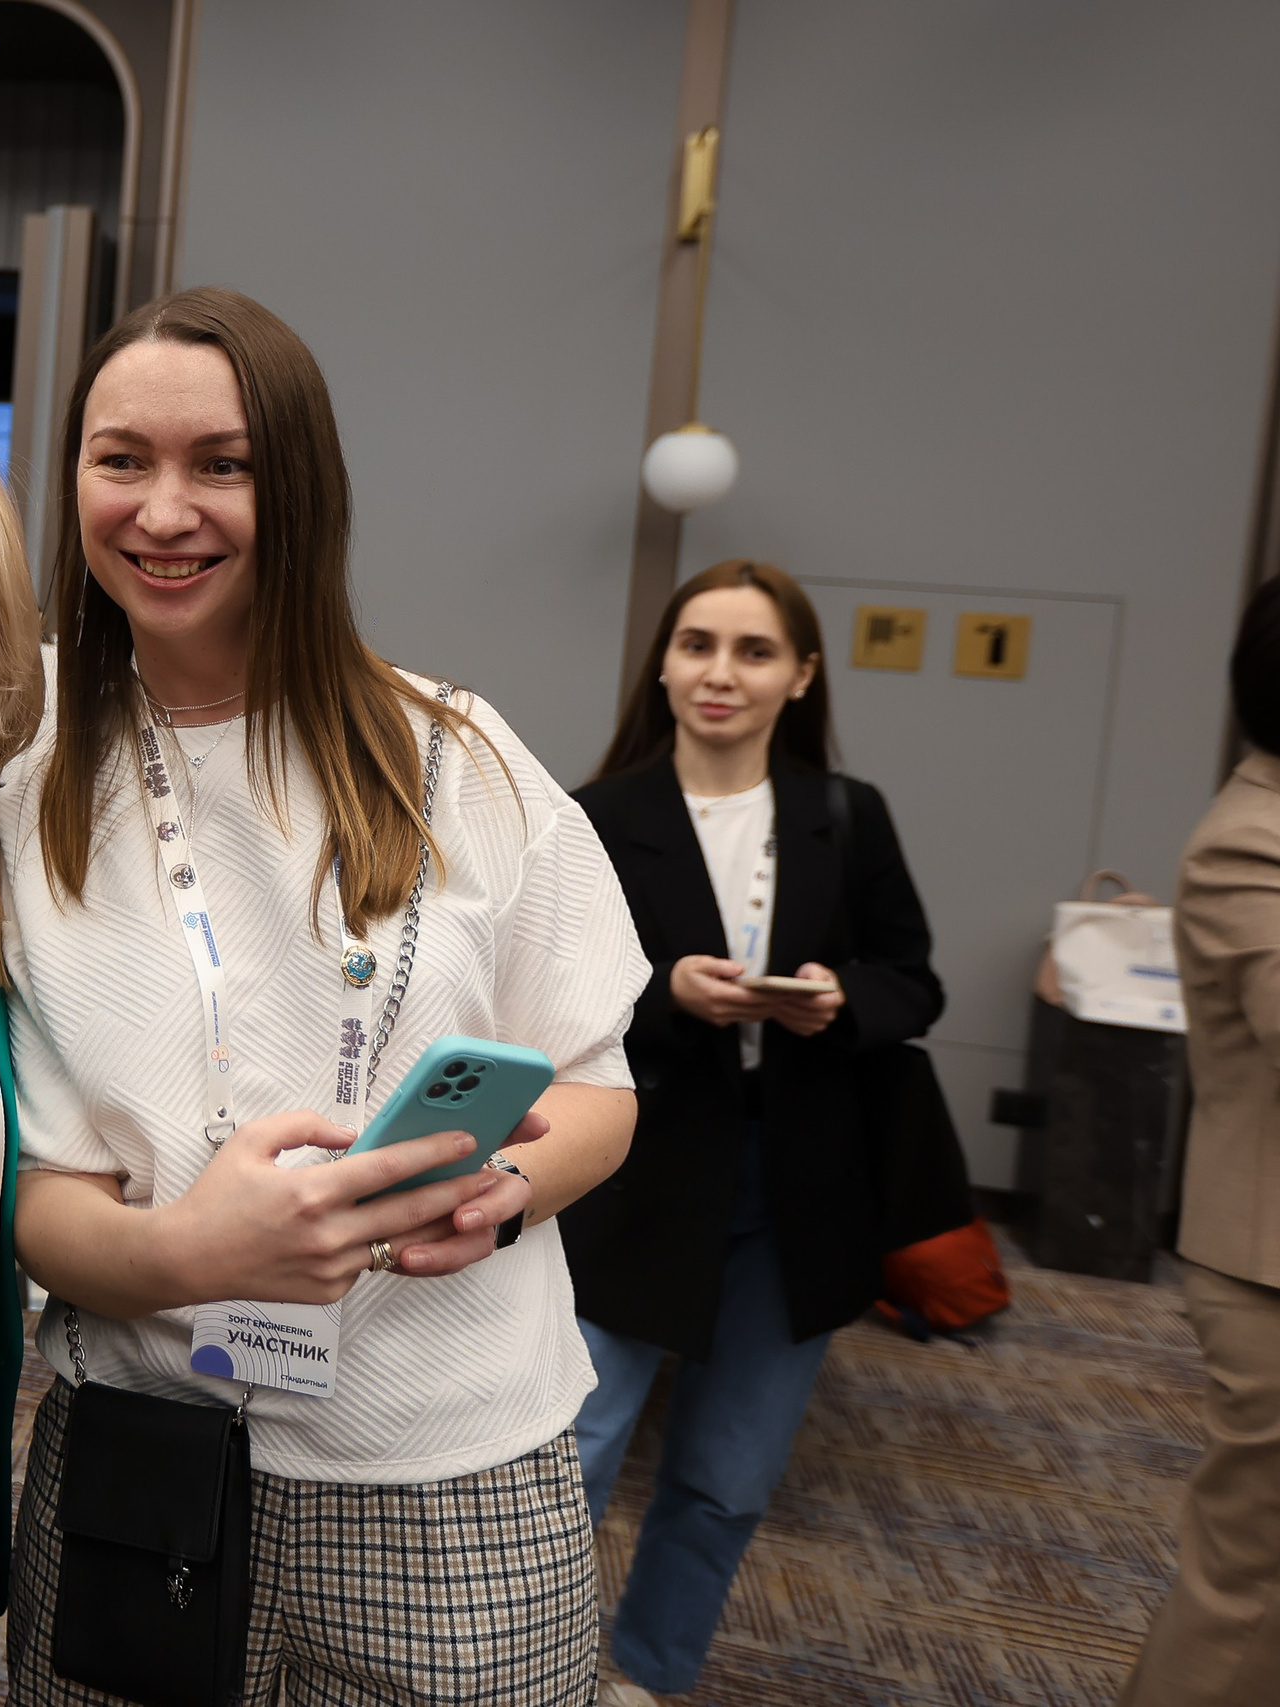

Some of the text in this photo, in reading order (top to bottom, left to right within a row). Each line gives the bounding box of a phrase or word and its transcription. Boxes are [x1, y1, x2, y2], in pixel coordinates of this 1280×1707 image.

[227, 1314, 313, 1338] SOFT ENGINEERING
[227, 1329, 330, 1364] УЧАСТНИК
[280, 1374, 328, 1390] СТАНДАРТНЫЙ
